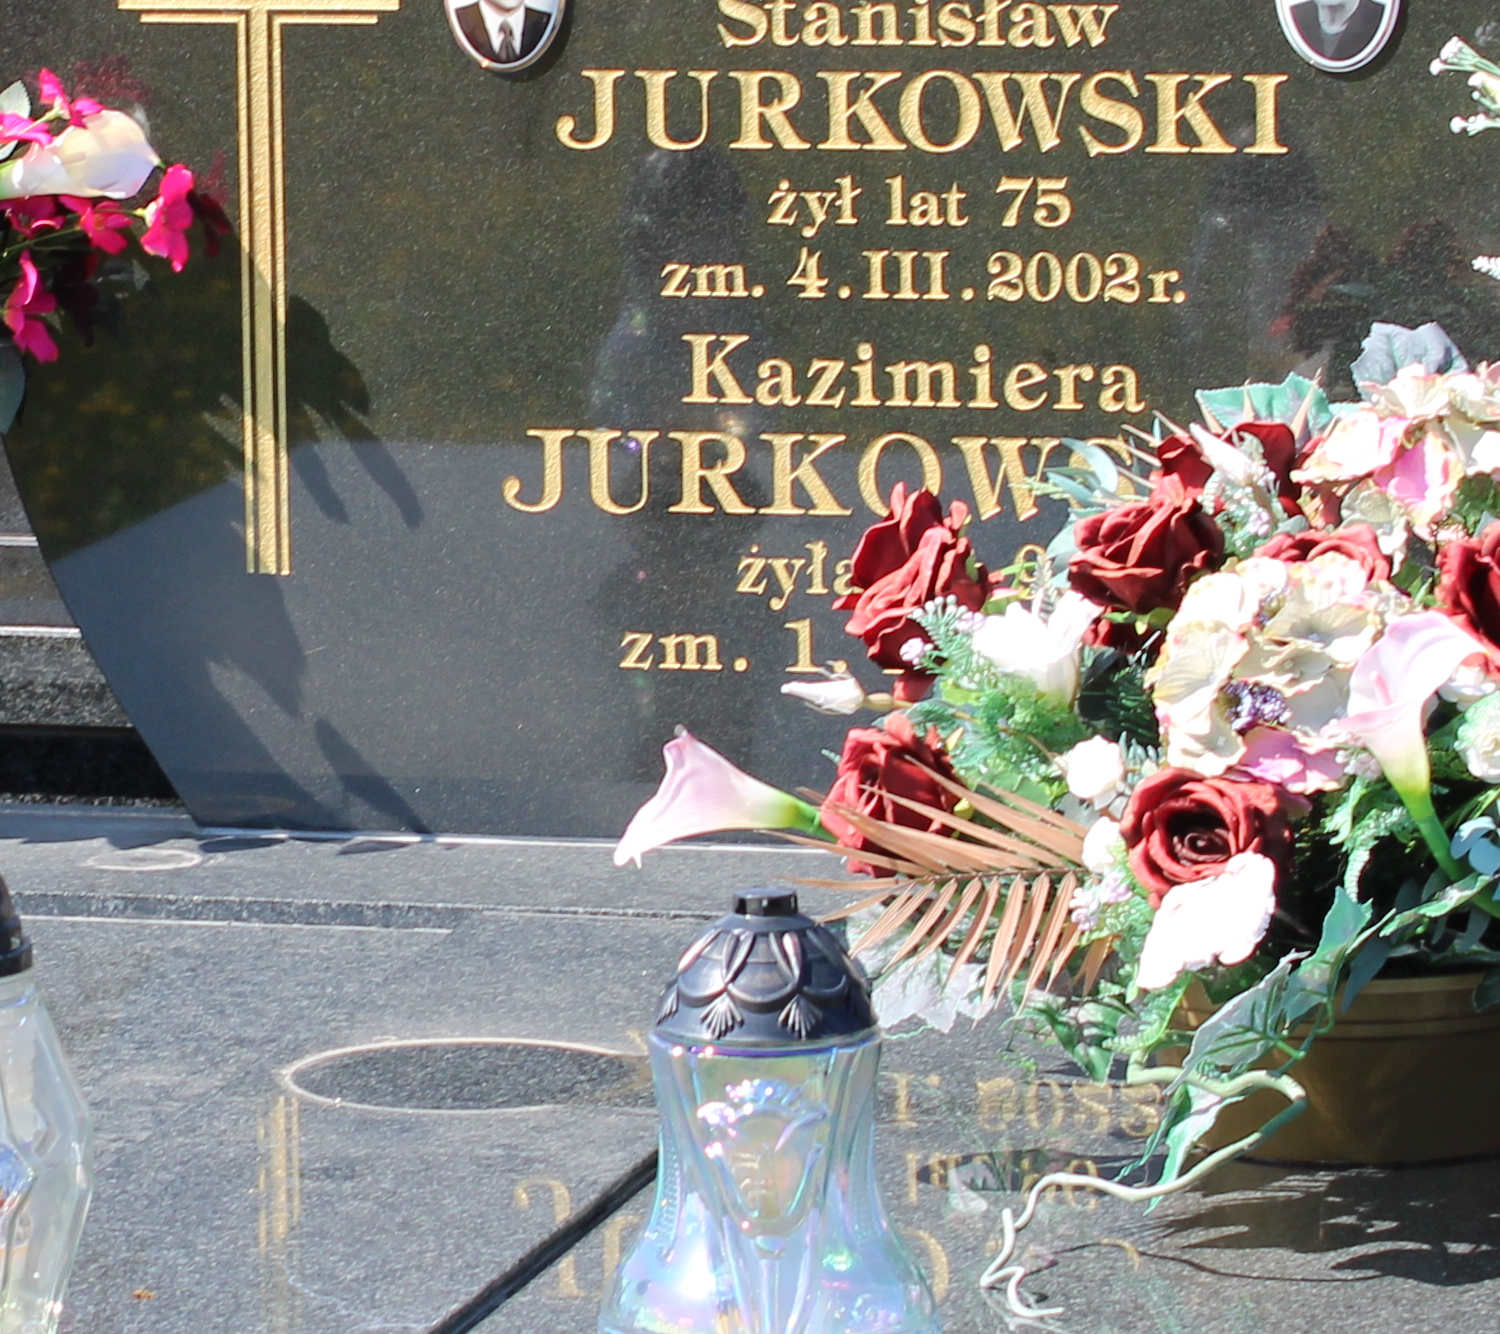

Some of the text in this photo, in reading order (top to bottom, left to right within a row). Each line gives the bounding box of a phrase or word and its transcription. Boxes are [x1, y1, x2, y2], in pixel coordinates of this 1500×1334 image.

[555, 68, 1291, 157] JURKOWSKI
[765, 177, 1074, 237] żył lat 75
[659, 262, 766, 299] zm.
[680, 331, 1147, 415] Kazimiera
[619, 630, 749, 673] zm.
